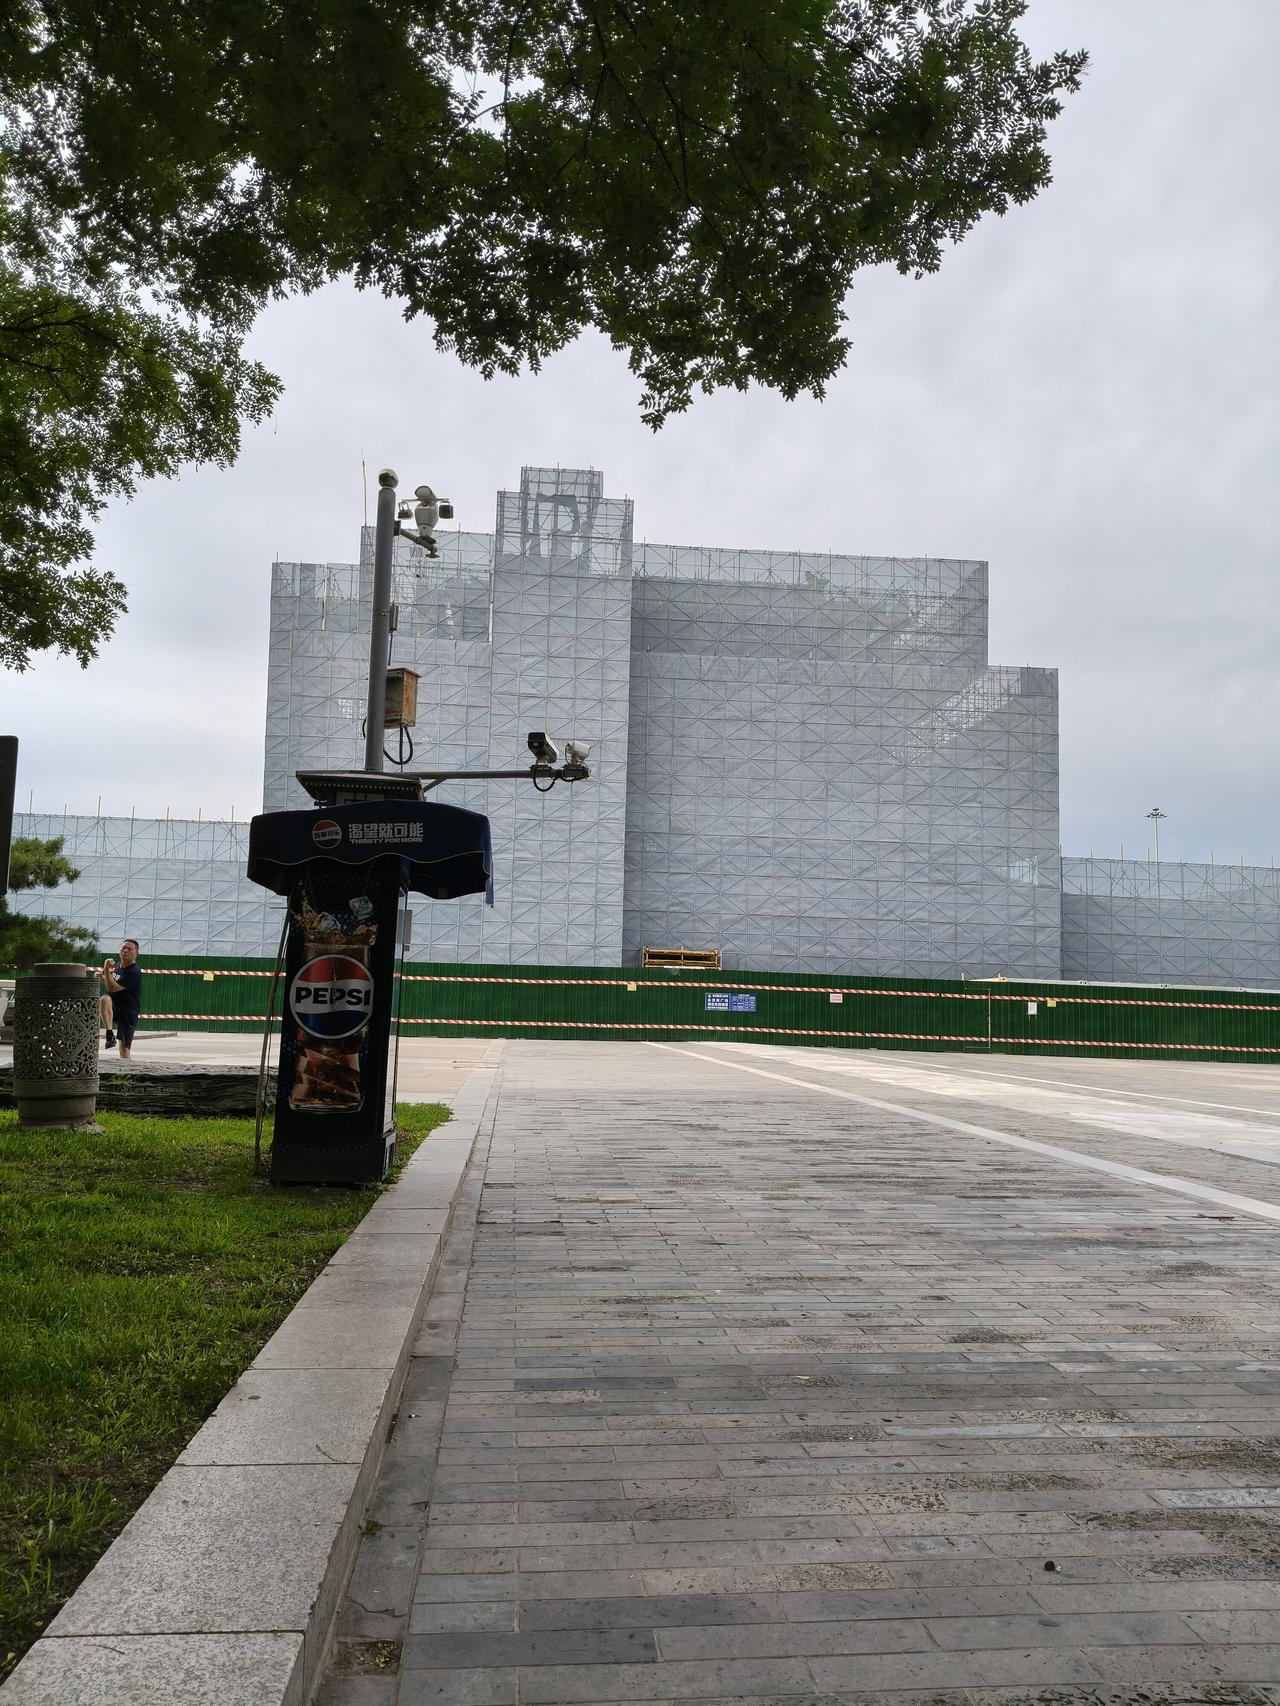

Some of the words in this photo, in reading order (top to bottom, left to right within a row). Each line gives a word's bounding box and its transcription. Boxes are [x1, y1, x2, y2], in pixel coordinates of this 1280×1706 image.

[348, 822, 424, 839] 渴望就可能
[295, 986, 371, 1006] PEPSI
